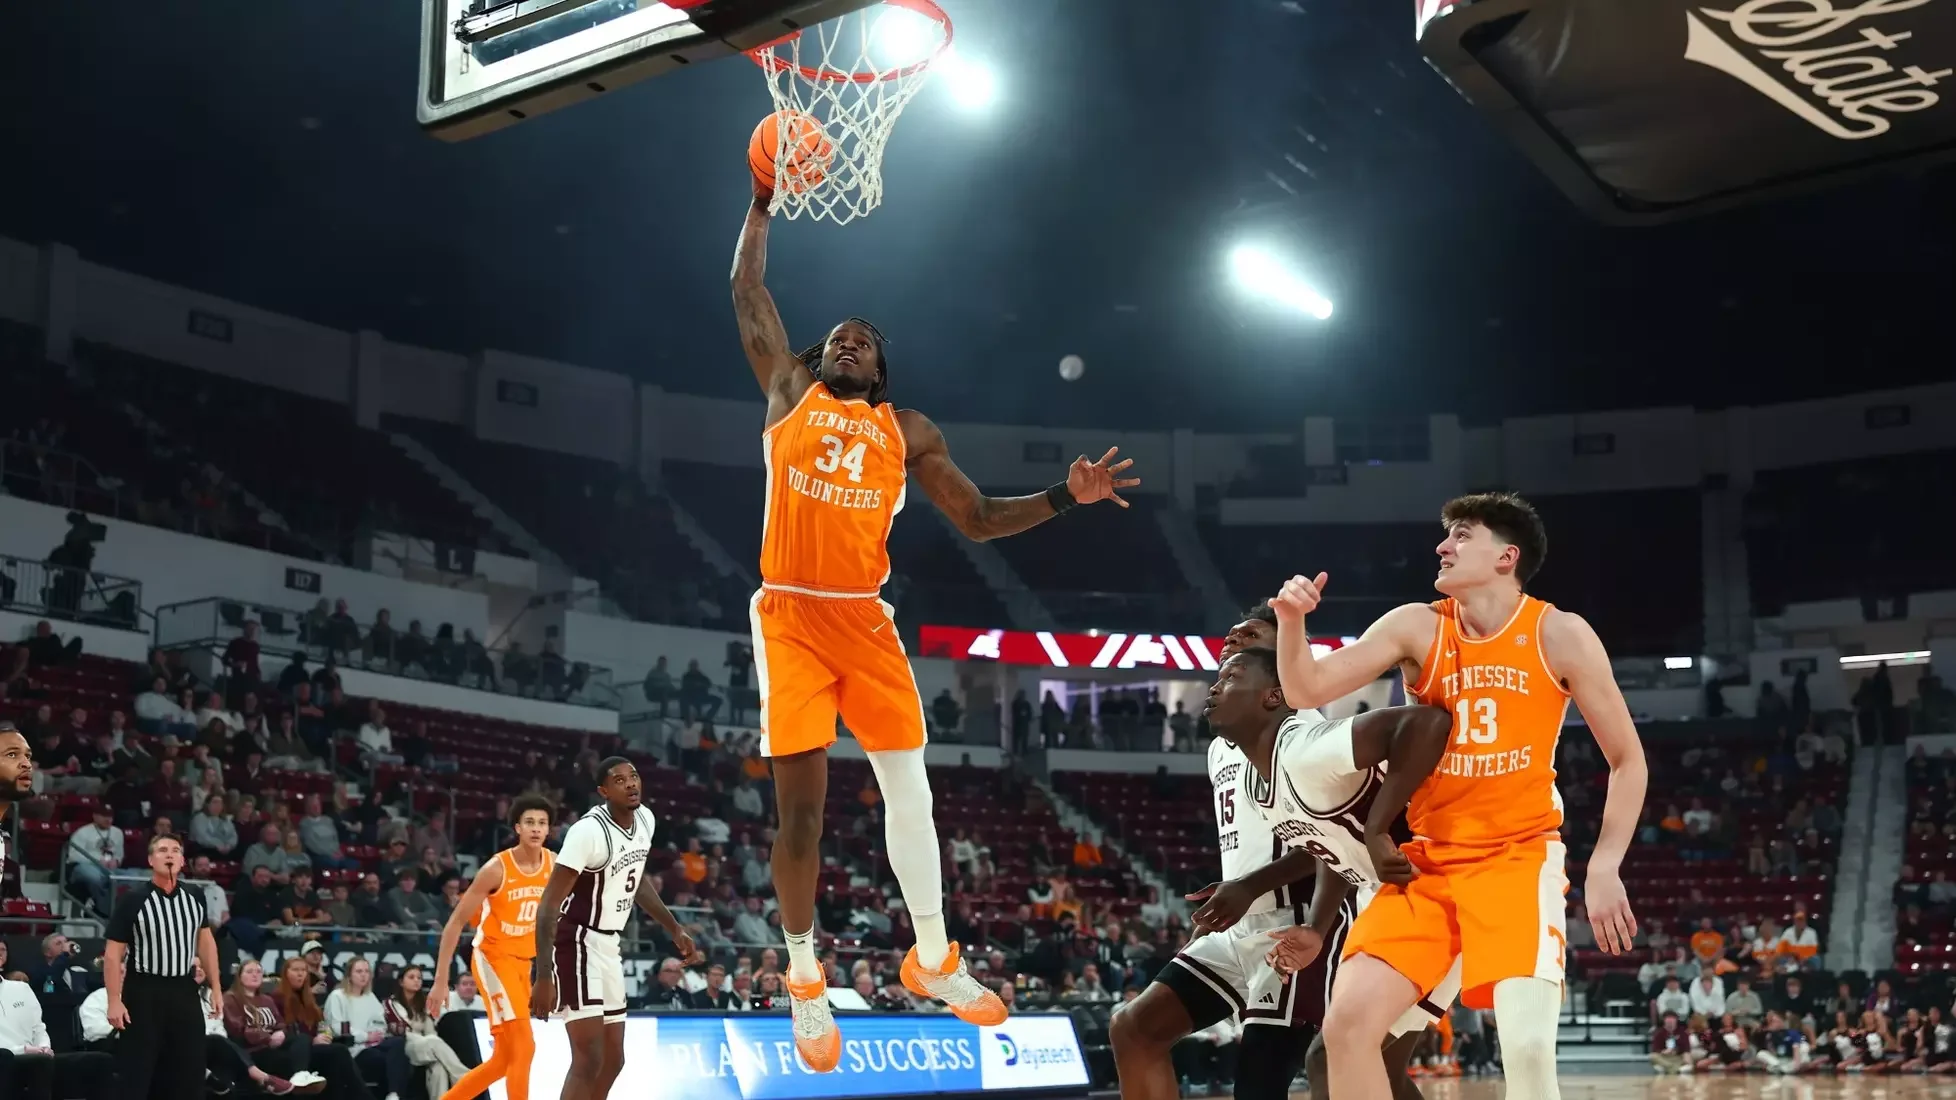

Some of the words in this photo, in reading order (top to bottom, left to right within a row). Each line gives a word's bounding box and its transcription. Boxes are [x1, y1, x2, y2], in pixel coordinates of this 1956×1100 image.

[807, 410, 888, 450] TENNESSEE
[815, 434, 867, 483] 34
[788, 465, 882, 509] VOLUNTEERS
[1442, 664, 1530, 697] TENESSEE
[1456, 698, 1498, 745] 13
[1219, 788, 1236, 827] 15
[625, 868, 636, 893] 5
[517, 900, 539, 922] 10
[846, 1038, 976, 1074] SUCCESS
